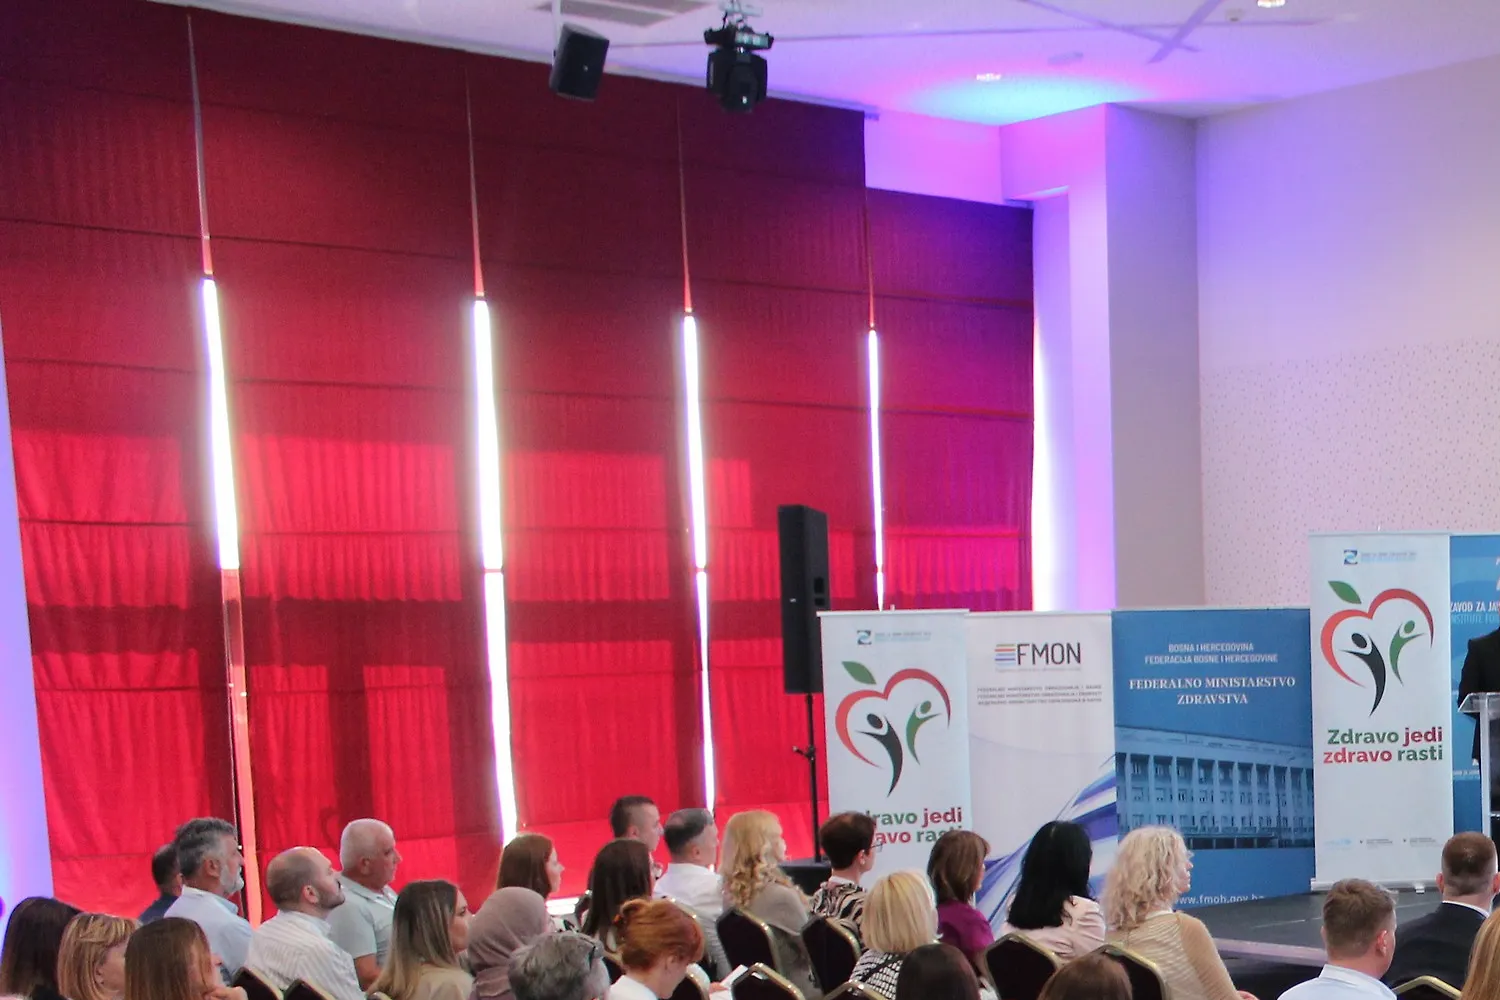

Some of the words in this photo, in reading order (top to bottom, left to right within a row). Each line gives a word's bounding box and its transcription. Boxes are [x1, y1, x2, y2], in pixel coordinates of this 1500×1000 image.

[1017, 641, 1081, 665] FMON
[1168, 643, 1195, 653] BOSNA
[1200, 642, 1254, 652] HERCEGOVINA
[1145, 655, 1193, 664] FEDERACIJA
[1193, 654, 1219, 664] BOSNE
[1225, 653, 1278, 663] HERCEGOVINE
[1129, 679, 1202, 690] FEDERALNO
[1205, 676, 1296, 689] MINISTARSTVO
[1177, 693, 1249, 705] ZDRAVSTVA
[1327, 728, 1400, 745] Zdravo
[1402, 726, 1443, 747] jedi
[1323, 747, 1392, 764] zdravo
[1397, 745, 1443, 761] rasti
[921, 807, 962, 828] jedi
